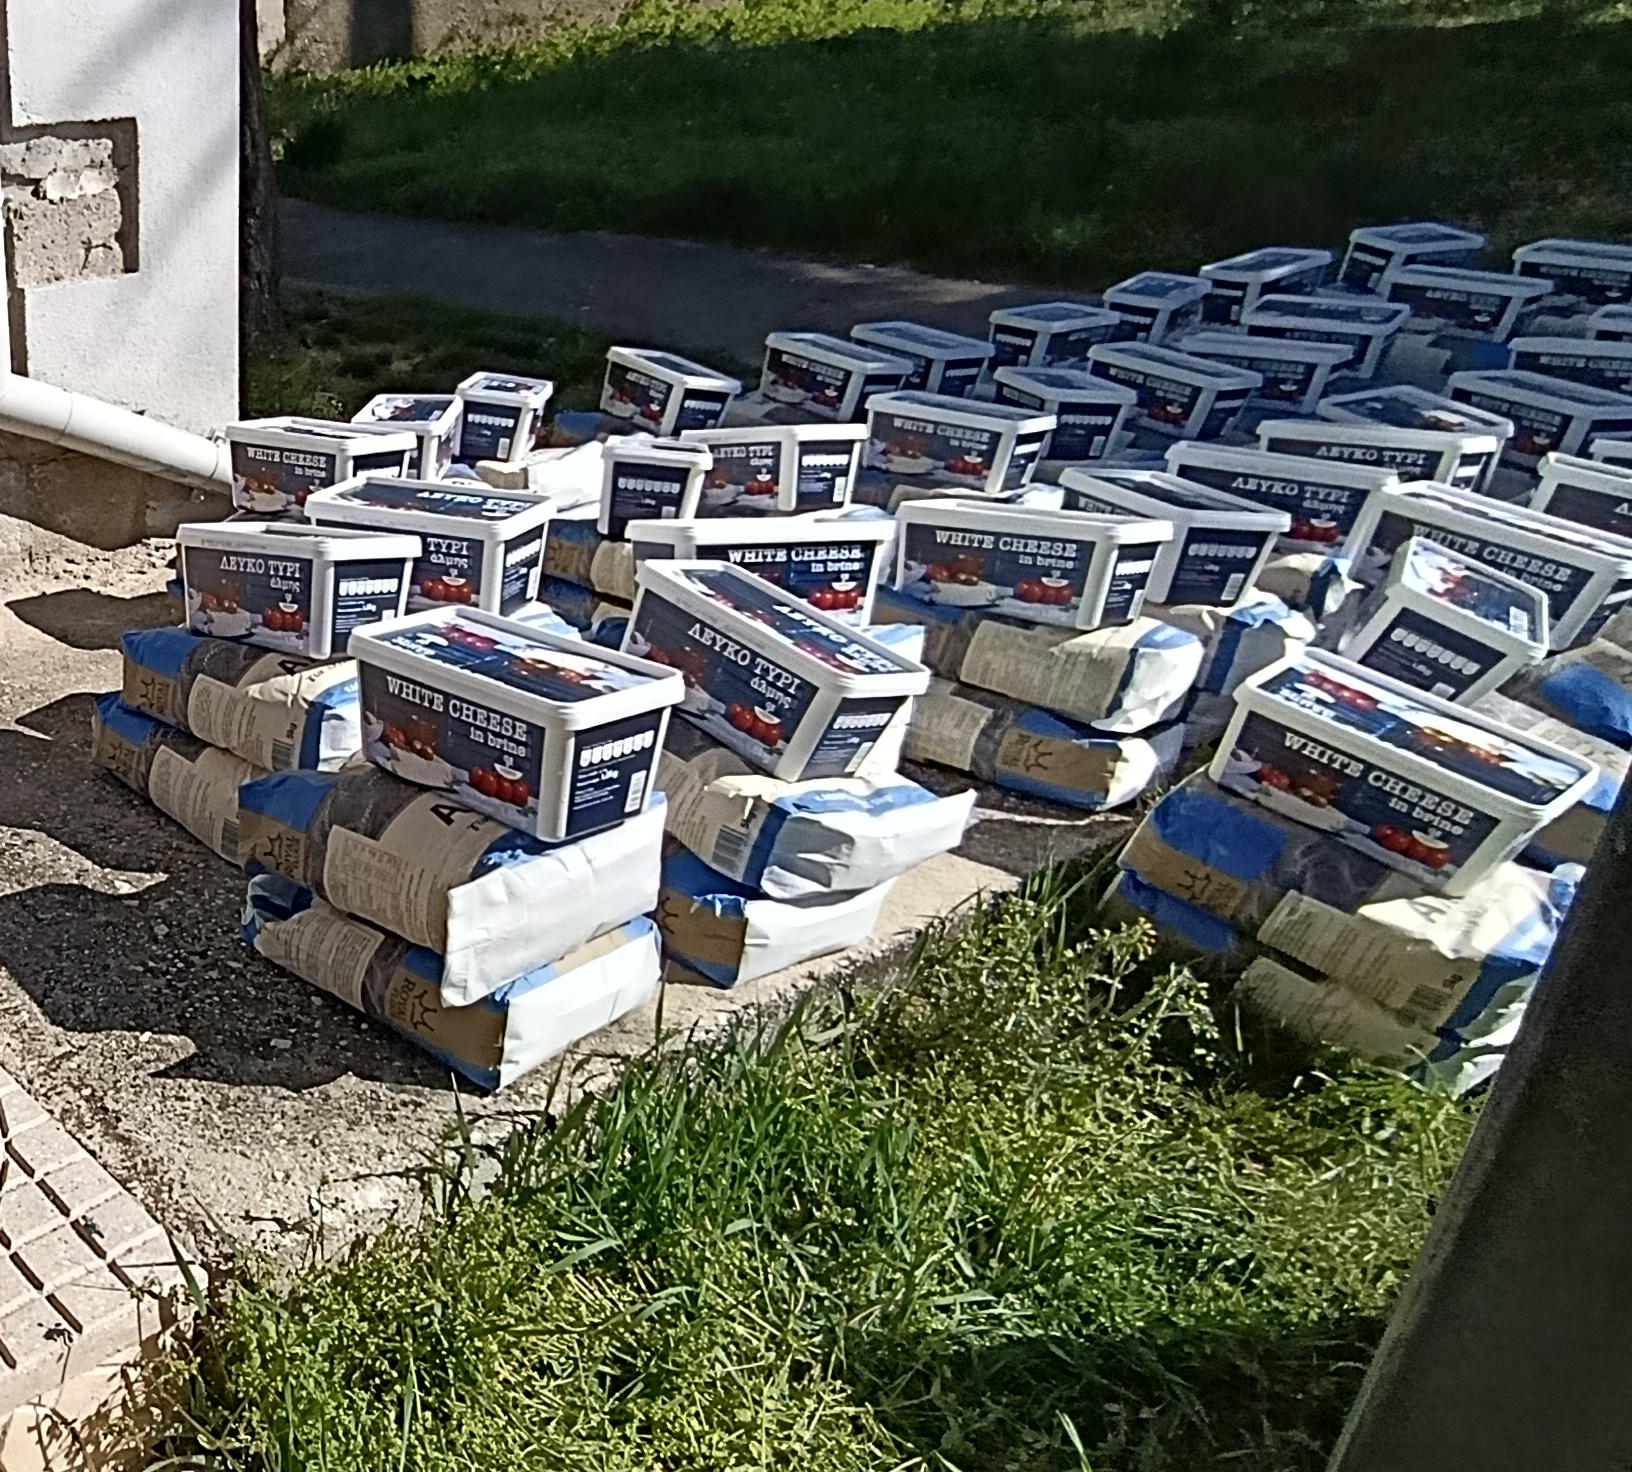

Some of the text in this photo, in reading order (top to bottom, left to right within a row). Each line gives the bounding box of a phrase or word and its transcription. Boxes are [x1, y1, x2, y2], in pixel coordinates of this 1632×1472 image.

[893, 417, 934, 434] WHITE
[247, 446, 327, 468] WHITE CHEESE
[1316, 445, 1427, 465] ΛΕΥΚΟ ΤΥΡΙ
[1232, 477, 1350, 503] ΛΕΥΚΟ ΤΥΡΙ
[427, 537, 468, 555] ΤΥΡΙ
[728, 545, 861, 564] WHITE CHEESE
[935, 529, 1077, 558] WHITE CHEESE
[220, 555, 301, 578] ΛΕΥΚΟ ΤΥΡΙ
[1019, 554, 1074, 569] in brine
[1483, 548, 1572, 583] CHEESE
[687, 623, 802, 694] ΛΕΥΚΟ ΤΥΡΙ
[750, 676, 792, 709] άλμης
[386, 675, 527, 742] WHITE CHEESE
[469, 726, 526, 758] in brine
[1284, 732, 1474, 825] WHITE CHEESE
[1388, 797, 1464, 836] in brine
